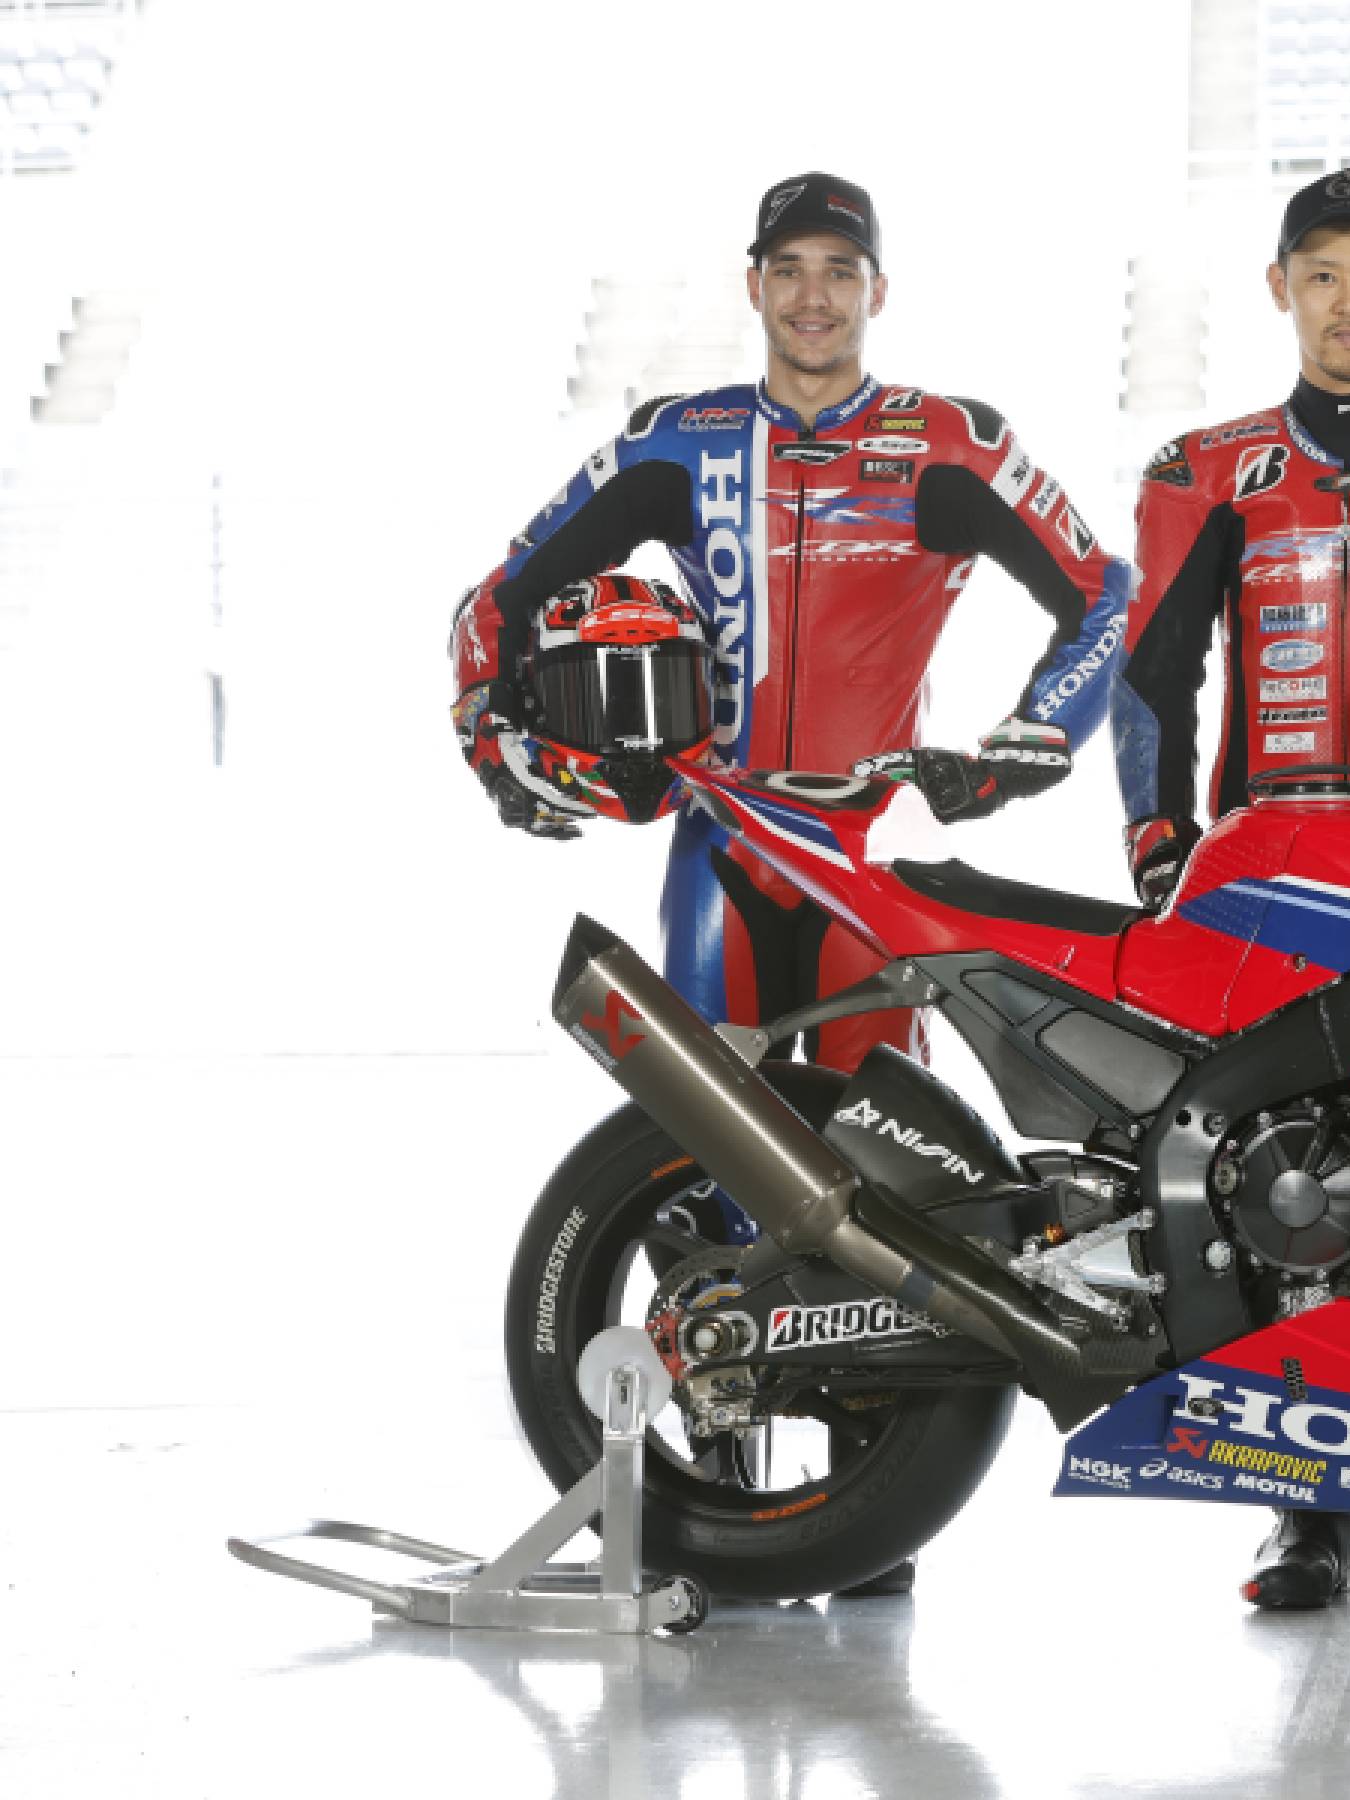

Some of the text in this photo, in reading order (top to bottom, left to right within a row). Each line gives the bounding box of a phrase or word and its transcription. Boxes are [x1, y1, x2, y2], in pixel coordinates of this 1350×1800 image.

[700, 449, 746, 770] HOND
[1030, 613, 1128, 721] HONDA
[536, 1206, 589, 1355] BRIDGESTONE
[1069, 1454, 1132, 1482] NGK
[1166, 1465, 1225, 1490] asics
[1232, 1473, 1318, 1503] MOTUL
